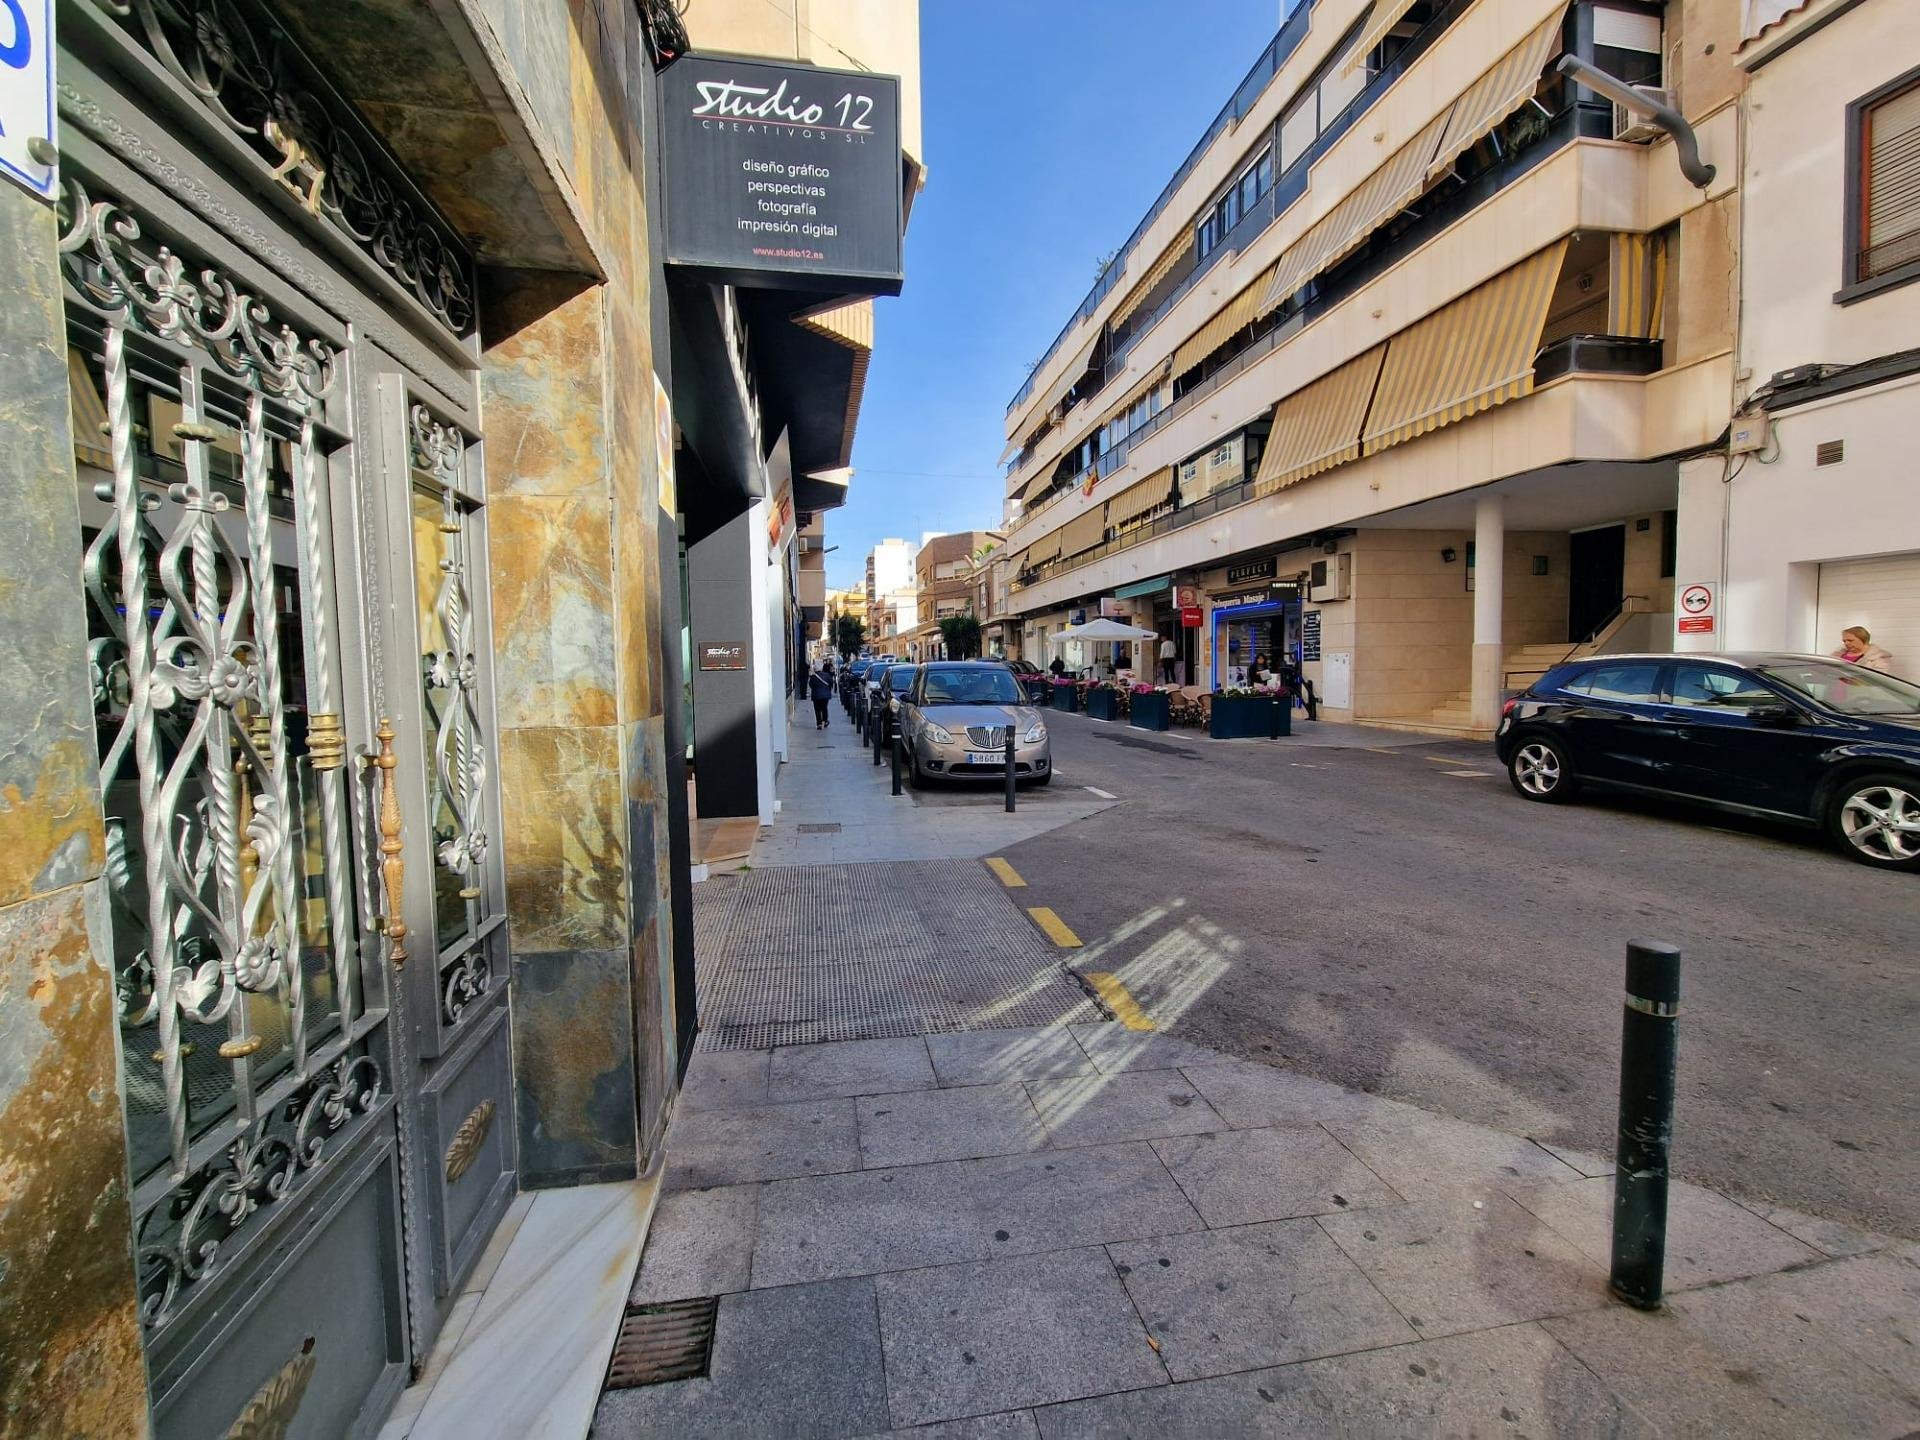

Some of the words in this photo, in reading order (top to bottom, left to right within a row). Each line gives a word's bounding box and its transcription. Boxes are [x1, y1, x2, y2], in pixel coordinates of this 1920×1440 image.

[692, 79, 822, 124] Studio
[834, 93, 874, 130] 12
[702, 119, 827, 141] CREATIVOS
[742, 158, 784, 175] diseño
[787, 163, 830, 179] gráfico
[748, 180, 826, 197] perspectivas
[757, 199, 817, 216] fotografía
[737, 217, 798, 234] impresión
[801, 222, 838, 238] digital
[752, 246, 824, 260] www.studio12.es
[1230, 563, 1268, 579] PERFECT
